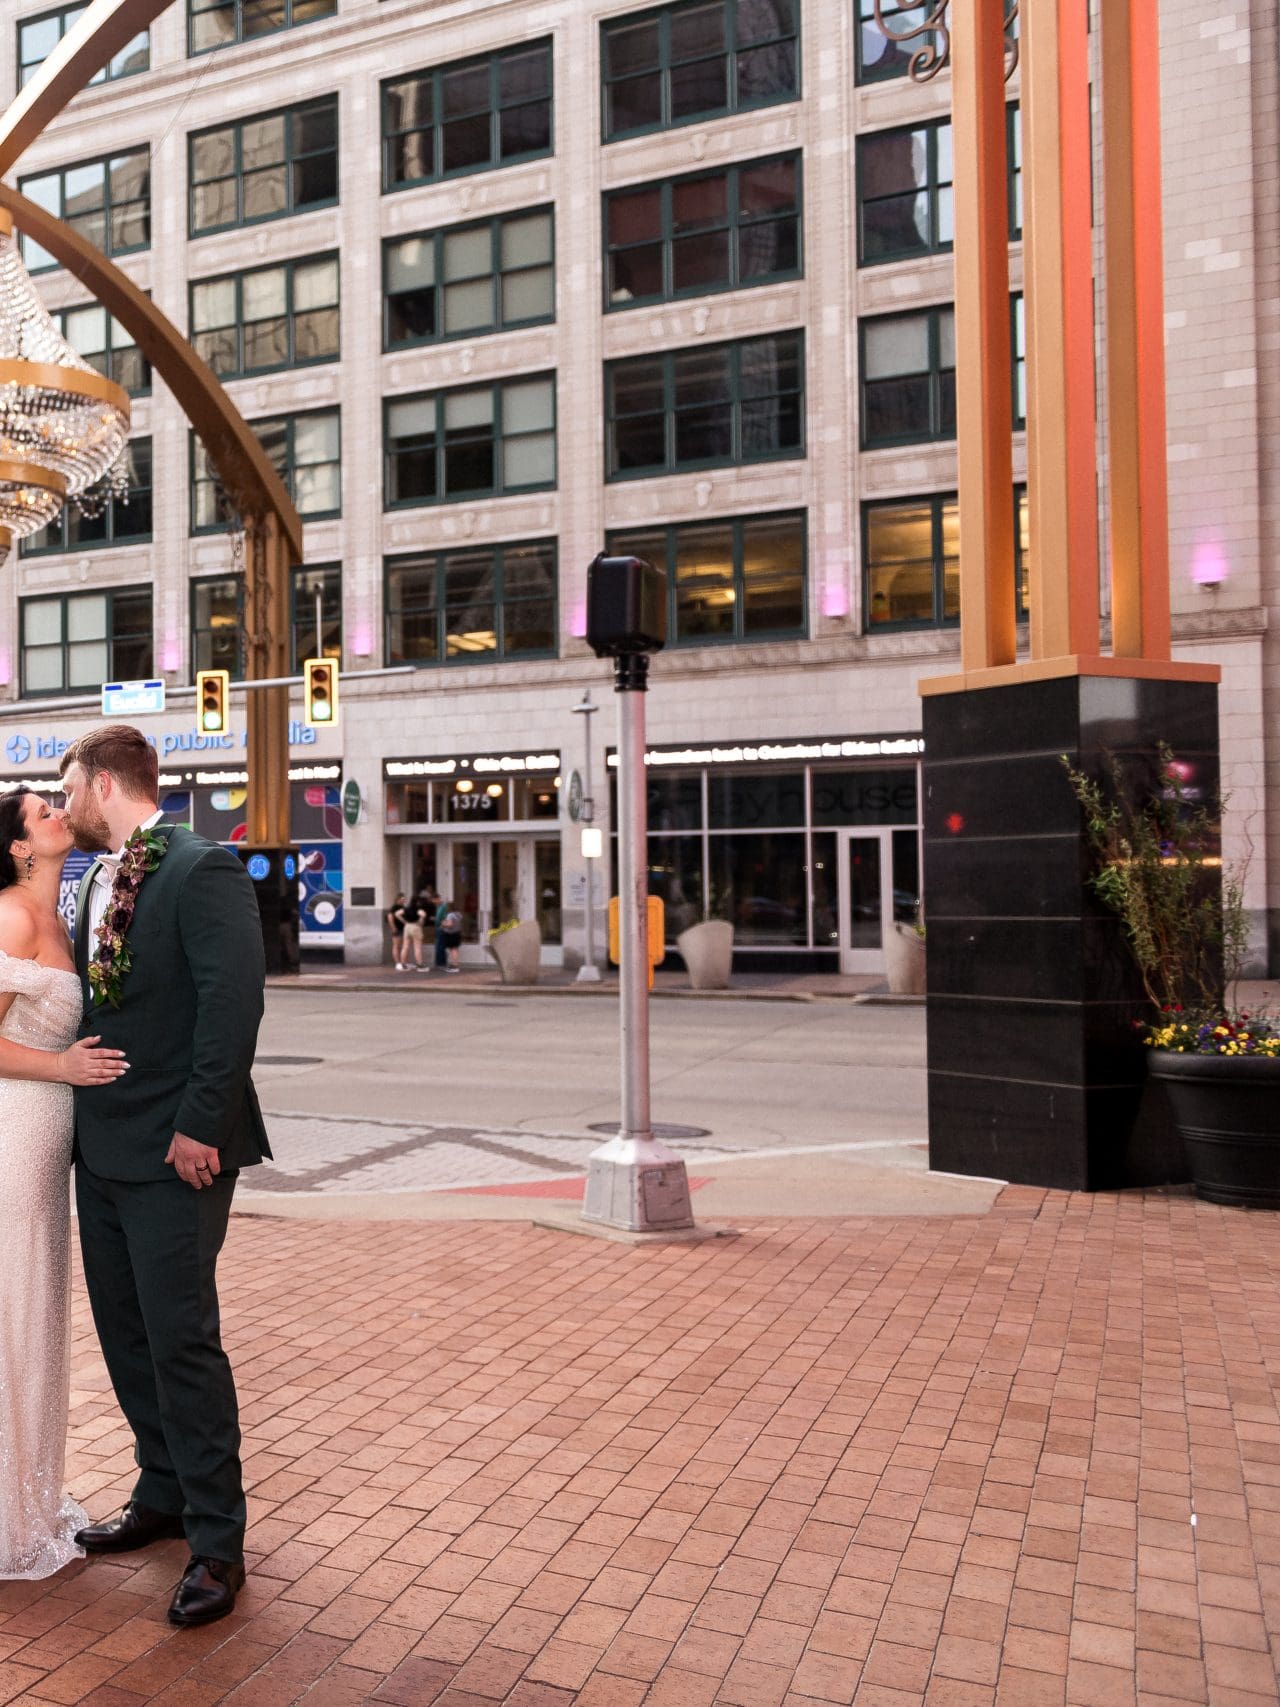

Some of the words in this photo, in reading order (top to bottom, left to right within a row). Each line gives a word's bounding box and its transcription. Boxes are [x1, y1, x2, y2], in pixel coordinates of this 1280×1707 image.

[162, 728, 232, 756] public
[451, 794, 492, 810] 1375
[60, 880, 81, 894] WE
[59, 893, 77, 907] TA
[57, 905, 77, 919] YO
